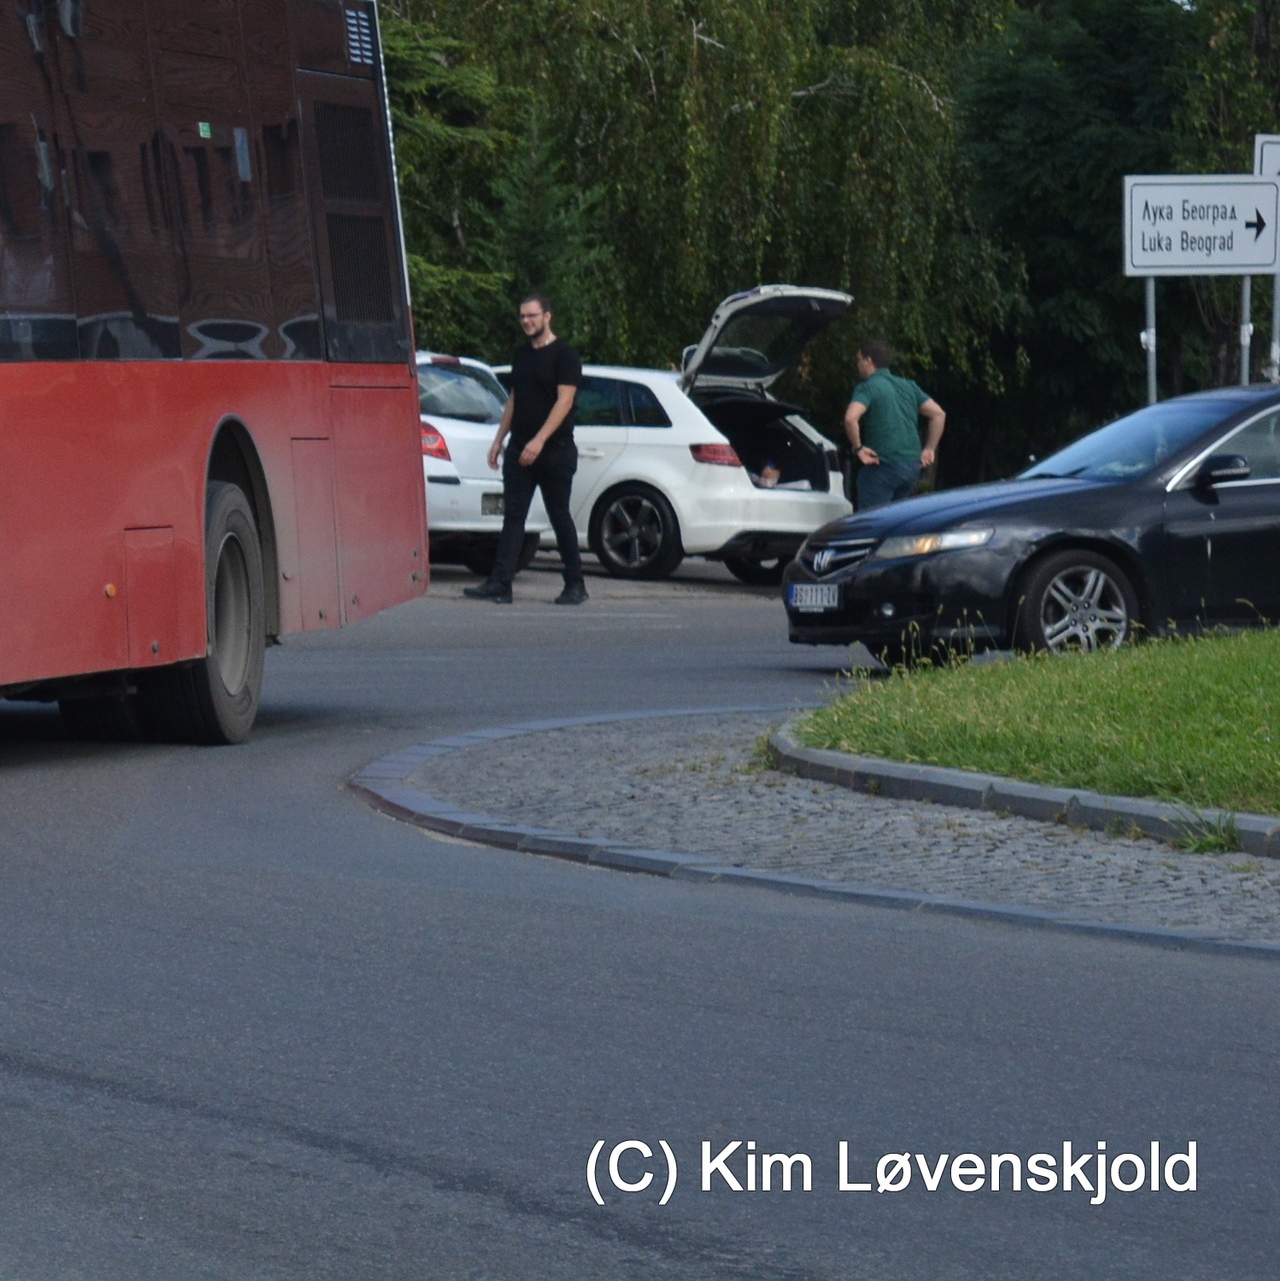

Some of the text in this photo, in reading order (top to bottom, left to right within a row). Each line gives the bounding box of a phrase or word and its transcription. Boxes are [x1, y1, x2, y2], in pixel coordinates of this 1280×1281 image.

[1142, 199, 1237, 226] Лука Београд
[1141, 230, 1234, 257] Luka Beograd
